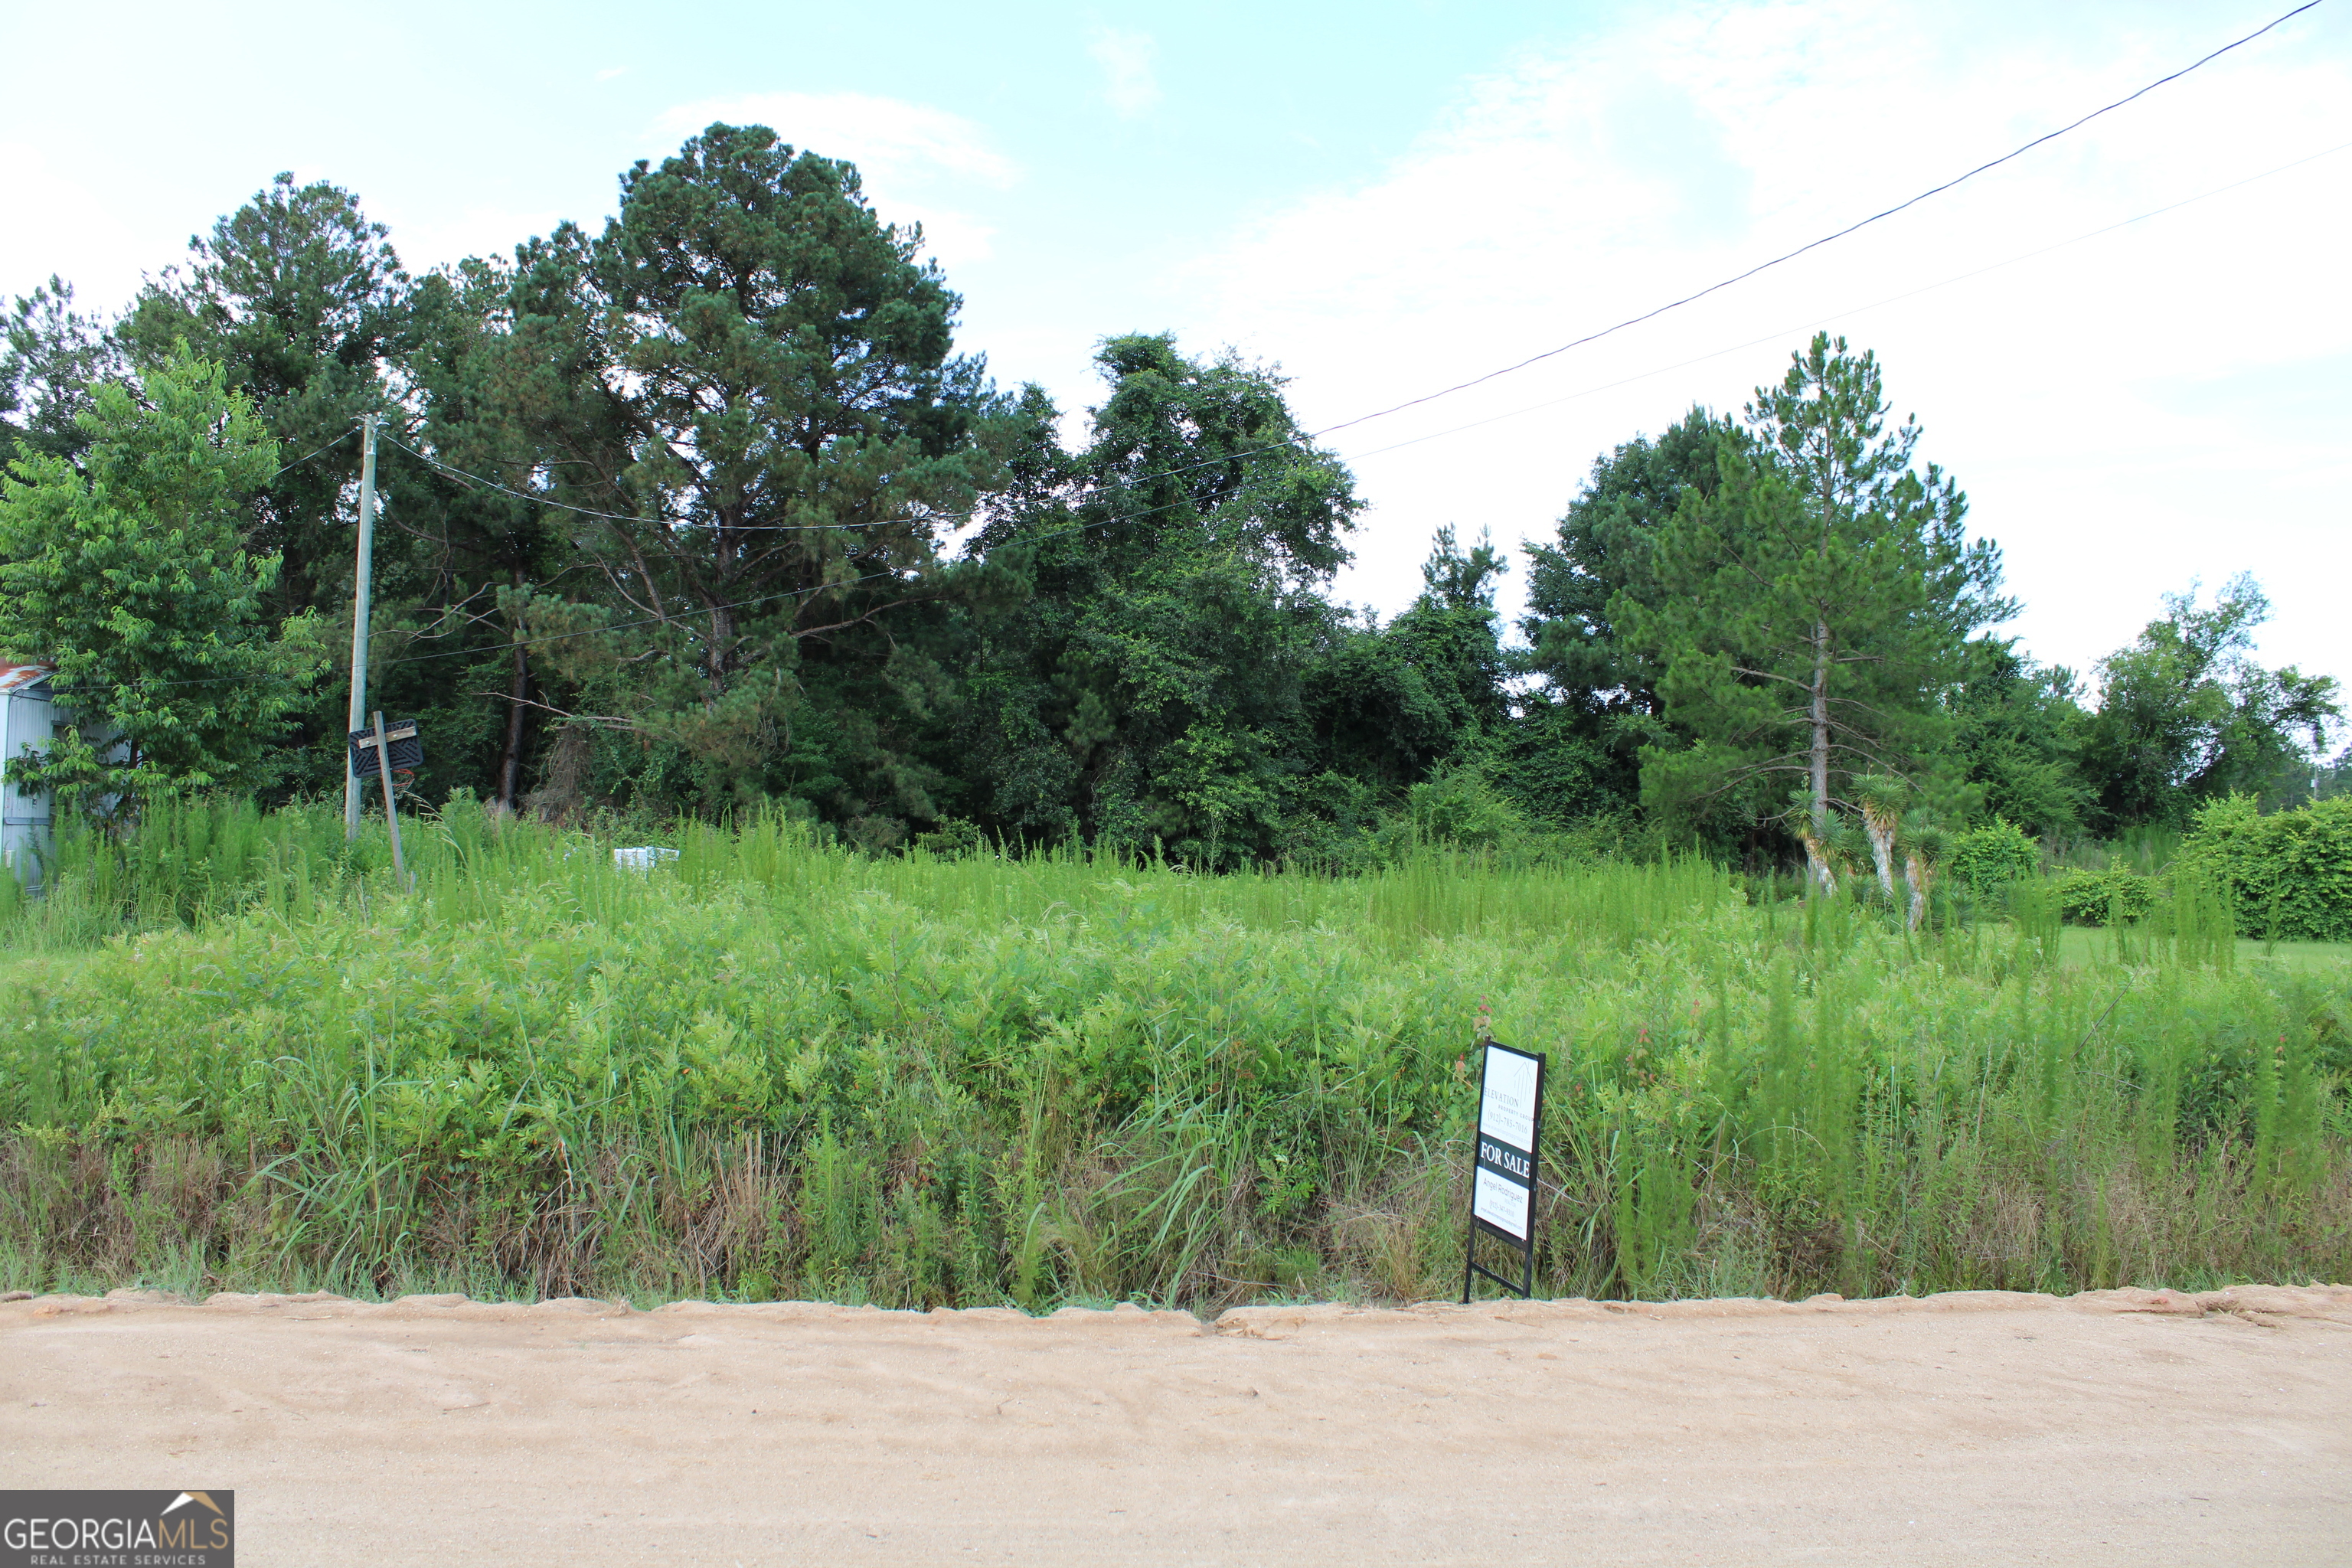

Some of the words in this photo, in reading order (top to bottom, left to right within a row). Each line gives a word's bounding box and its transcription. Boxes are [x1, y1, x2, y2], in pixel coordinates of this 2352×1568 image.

[1484, 1087, 1519, 1108] ELEVATION
[1480, 1141, 1502, 1167] FOR
[1504, 1152, 1530, 1178] SALE
[1483, 1178, 1498, 1191] Angel
[1498, 1184, 1523, 1204] Rodriguez
